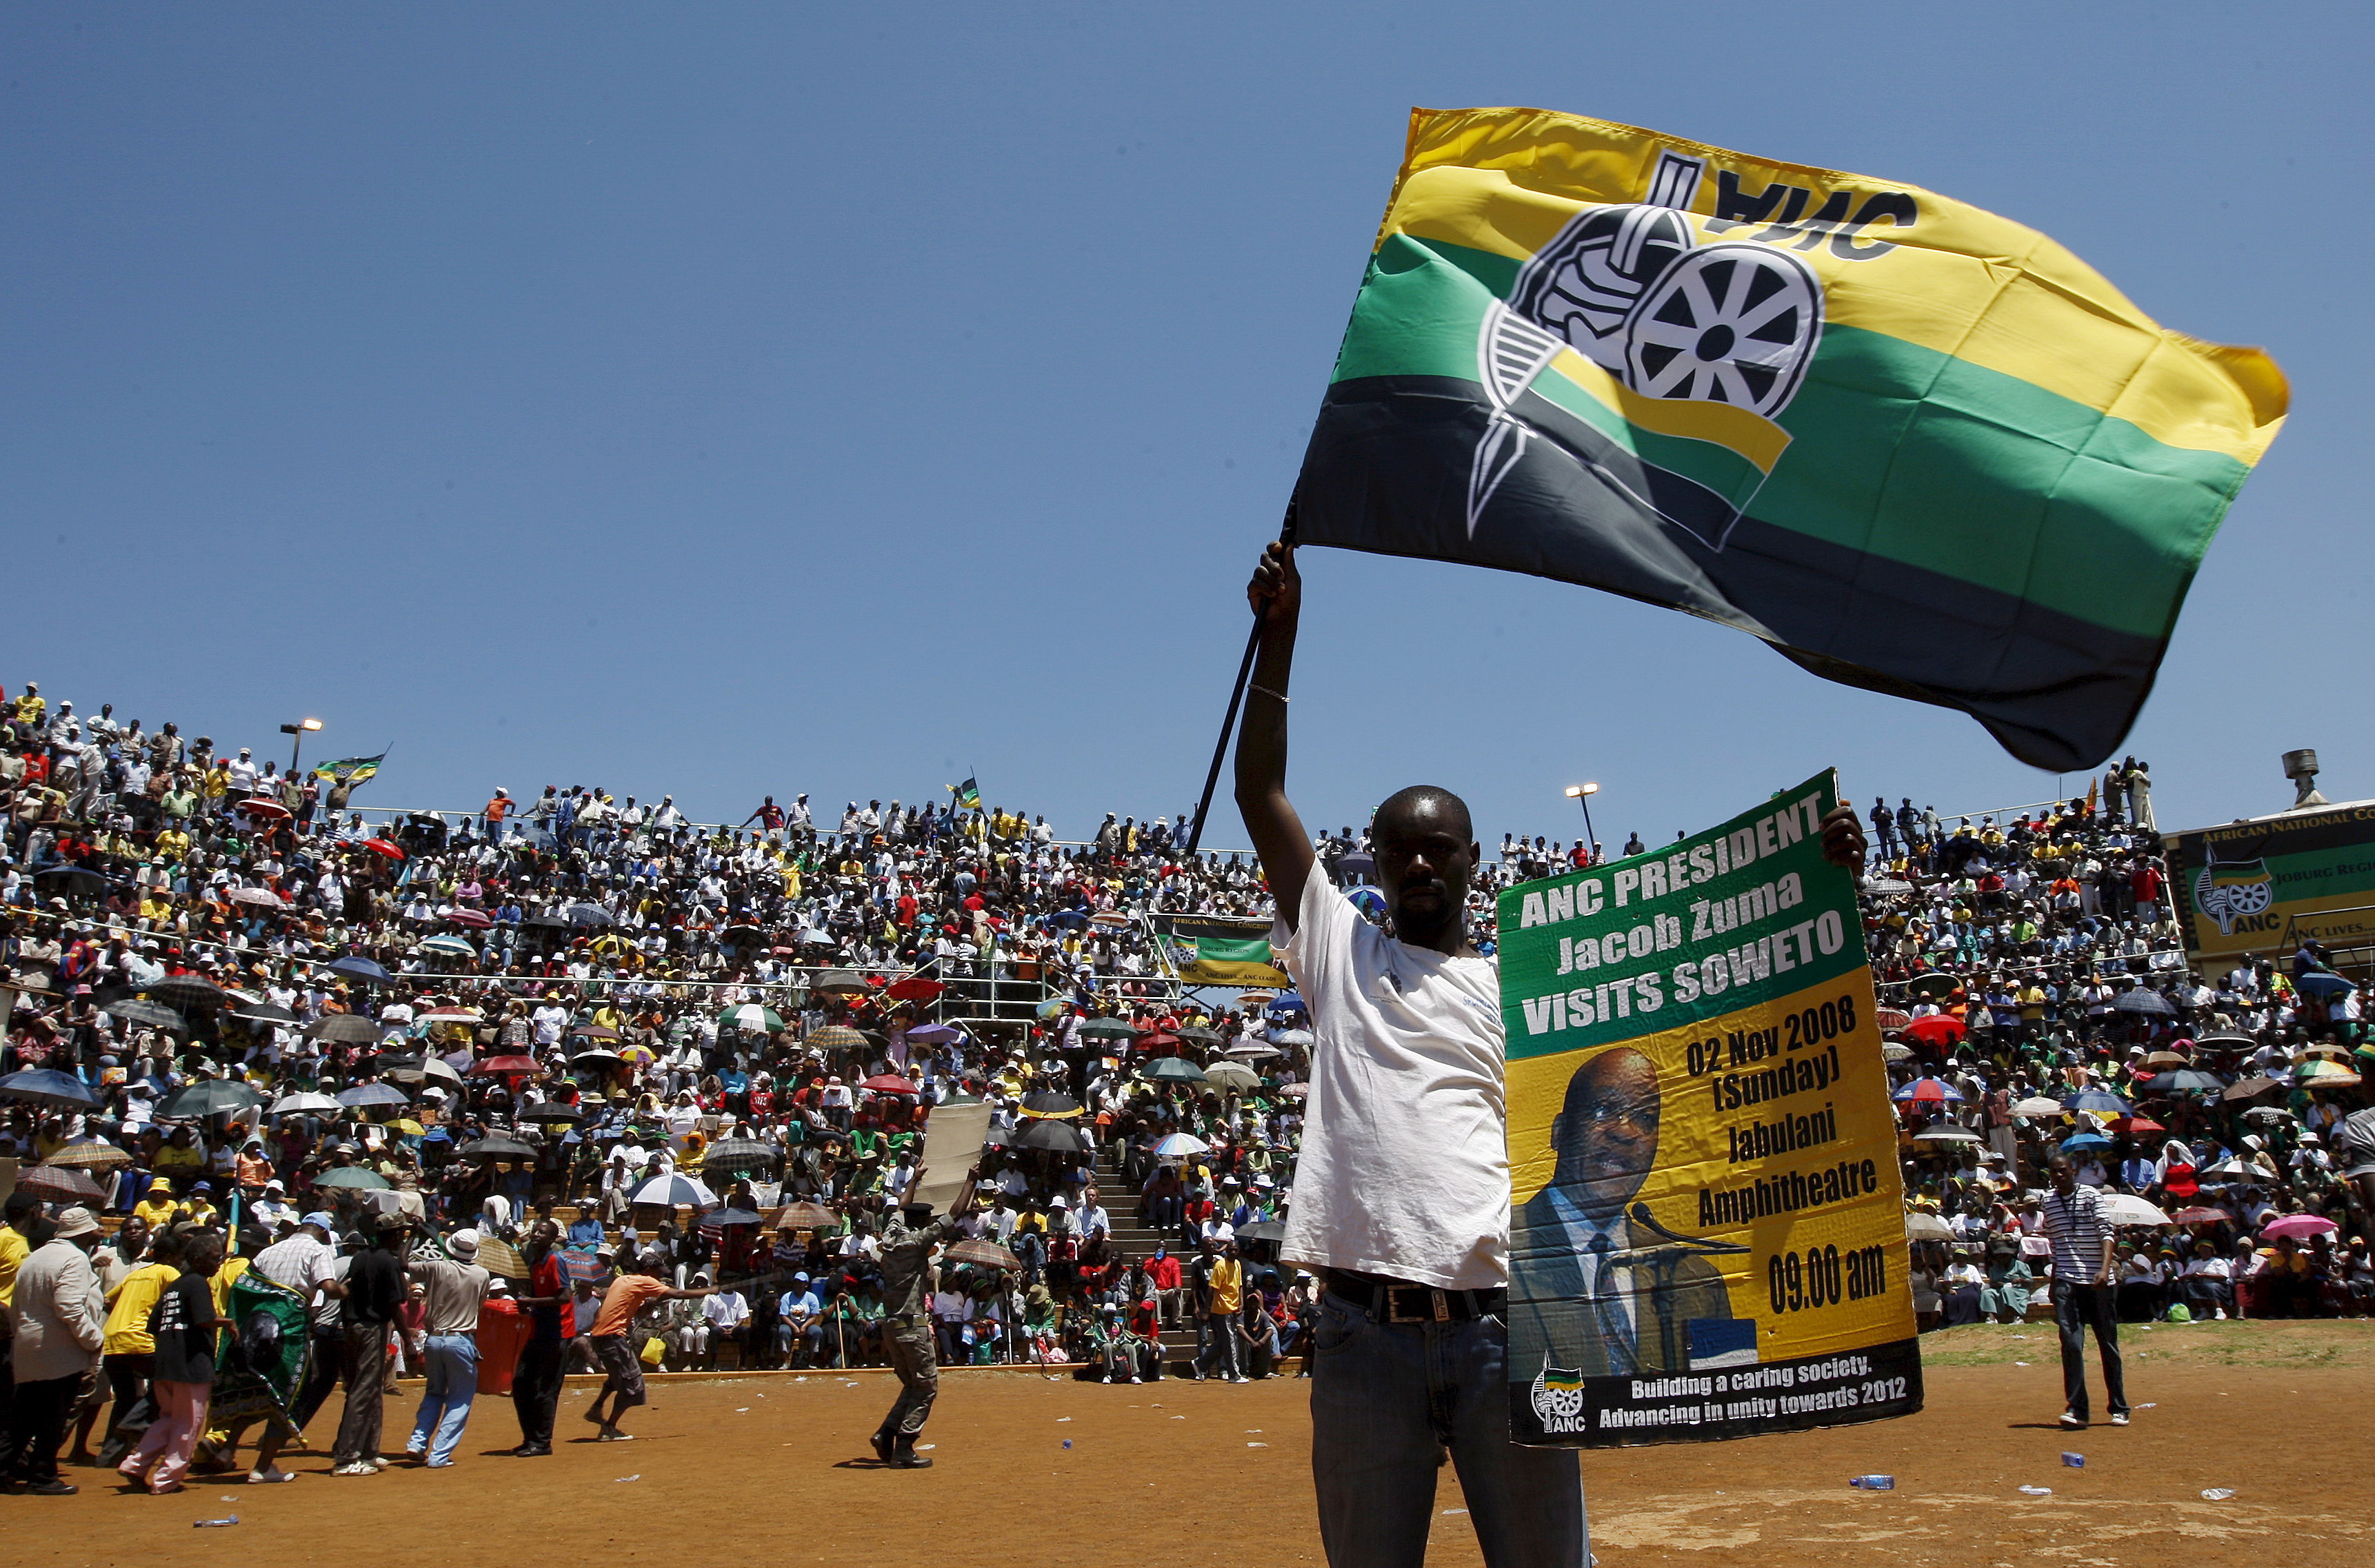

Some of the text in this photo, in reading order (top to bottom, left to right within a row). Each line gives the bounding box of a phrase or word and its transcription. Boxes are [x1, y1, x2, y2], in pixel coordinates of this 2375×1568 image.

[2202, 825, 2267, 843] AFRICAN
[2271, 812, 2351, 832] NATIONAL
[1519, 790, 1822, 929] ANC PRESIDENT
[2276, 867, 2333, 885] JOBURG
[1172, 917, 1271, 929] AFRICAN NATIONAL CONGRESS
[1556, 872, 1803, 976] Jacob Zuma
[2234, 912, 2281, 934] ANC
[1177, 964, 1198, 972] ANC
[1521, 909, 1844, 1036] VISITS SOWETO
[1686, 994, 1856, 1077] 02 Nov 2008
[1728, 1102, 1836, 1164] Jabulani
[1698, 1158, 1876, 1227] Amphitheatre
[1769, 1243, 1886, 1314] 09.00 am
[1599, 1376, 1906, 1429] Advancing in unity towards 2012
[1632, 1355, 1872, 1399] Building a caring society.
[1552, 1416, 1585, 1432] ANC
